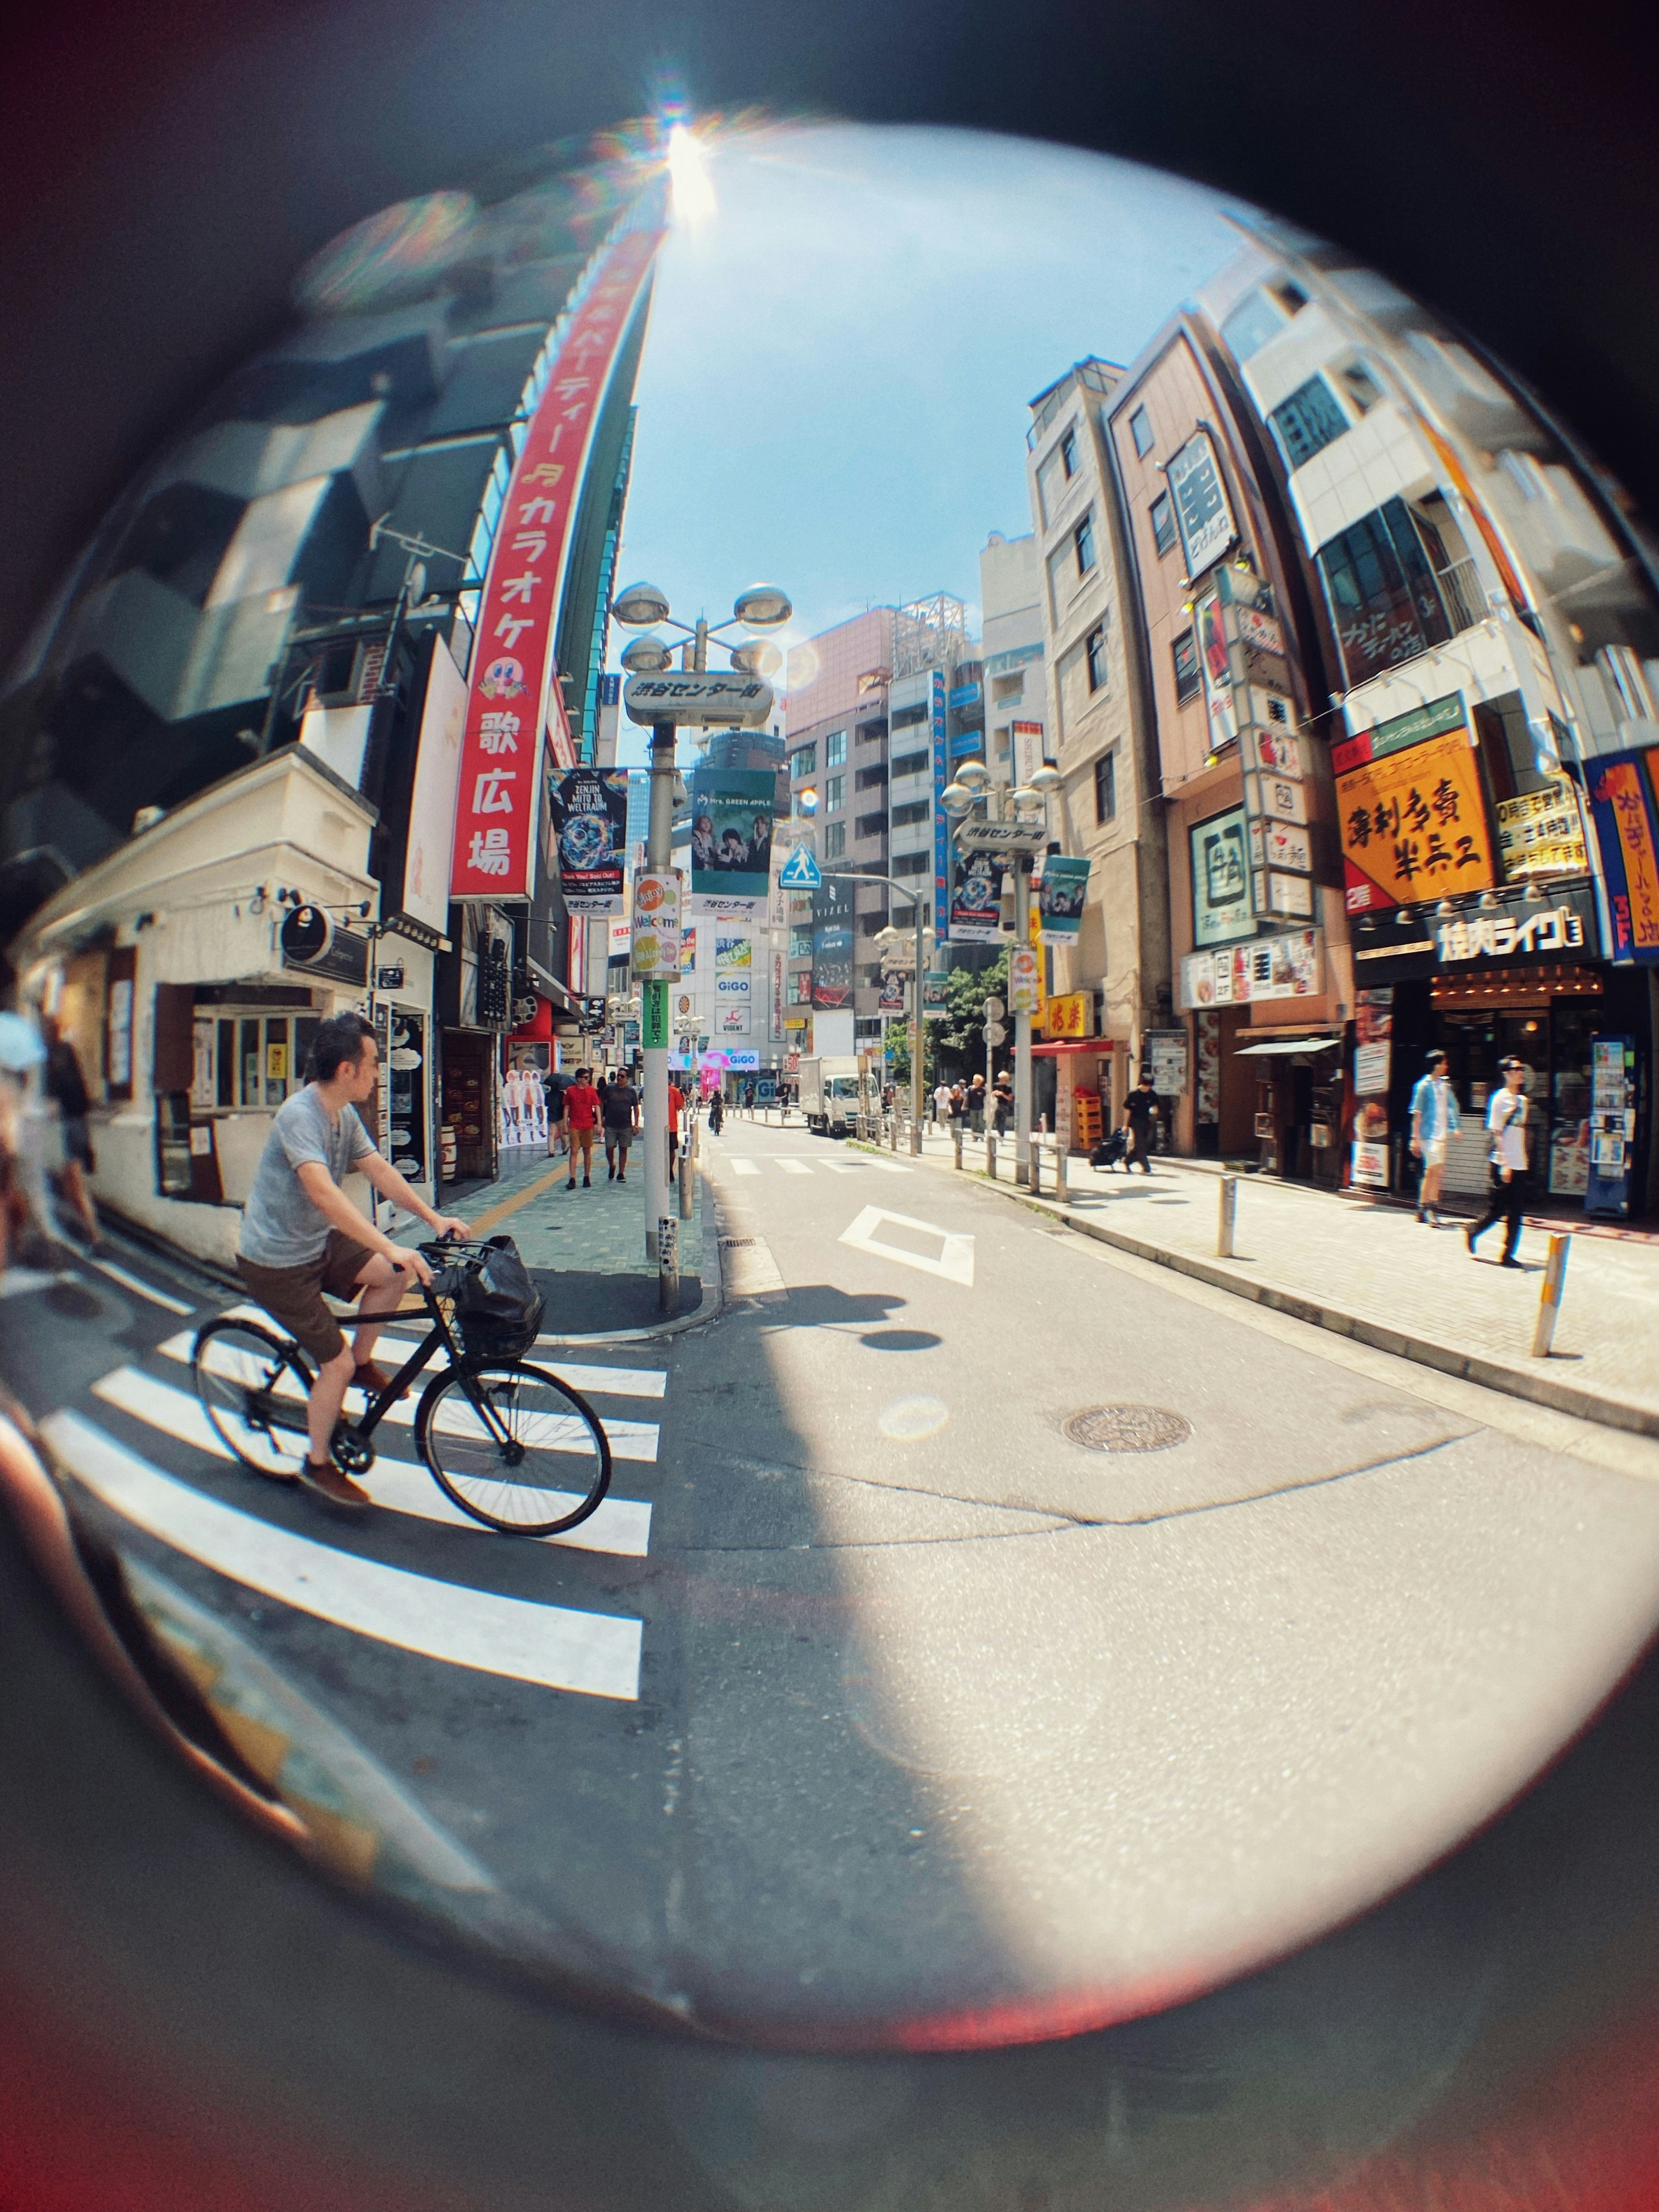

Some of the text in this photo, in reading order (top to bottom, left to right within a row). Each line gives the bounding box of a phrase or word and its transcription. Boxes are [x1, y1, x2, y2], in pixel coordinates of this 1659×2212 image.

[493, 496, 555, 649] カラオケ
[631, 681, 763, 698] 渋谷センター街
[467, 711, 521, 876] 歌広場
[575, 785, 600, 794] ZENJIN
[572, 793, 602, 803] MITO TO
[567, 802, 607, 812] WELTRAUM
[966, 827, 1046, 841] 渋谷センター街
[637, 887, 663, 905] Enjoy
[568, 900, 613, 908] 渋谷センター街
[703, 899, 757, 910] 渋谷センター街
[816, 904, 849, 917] VIZEL
[634, 915, 679, 929] Welcome
[1438, 910, 1564, 963] 焼肉ライク
[716, 939, 735, 949] 渋谷
[718, 981, 748, 991] GiGO
[1217, 985, 1229, 996] 2F
[730, 1056, 755, 1064] GiGO
